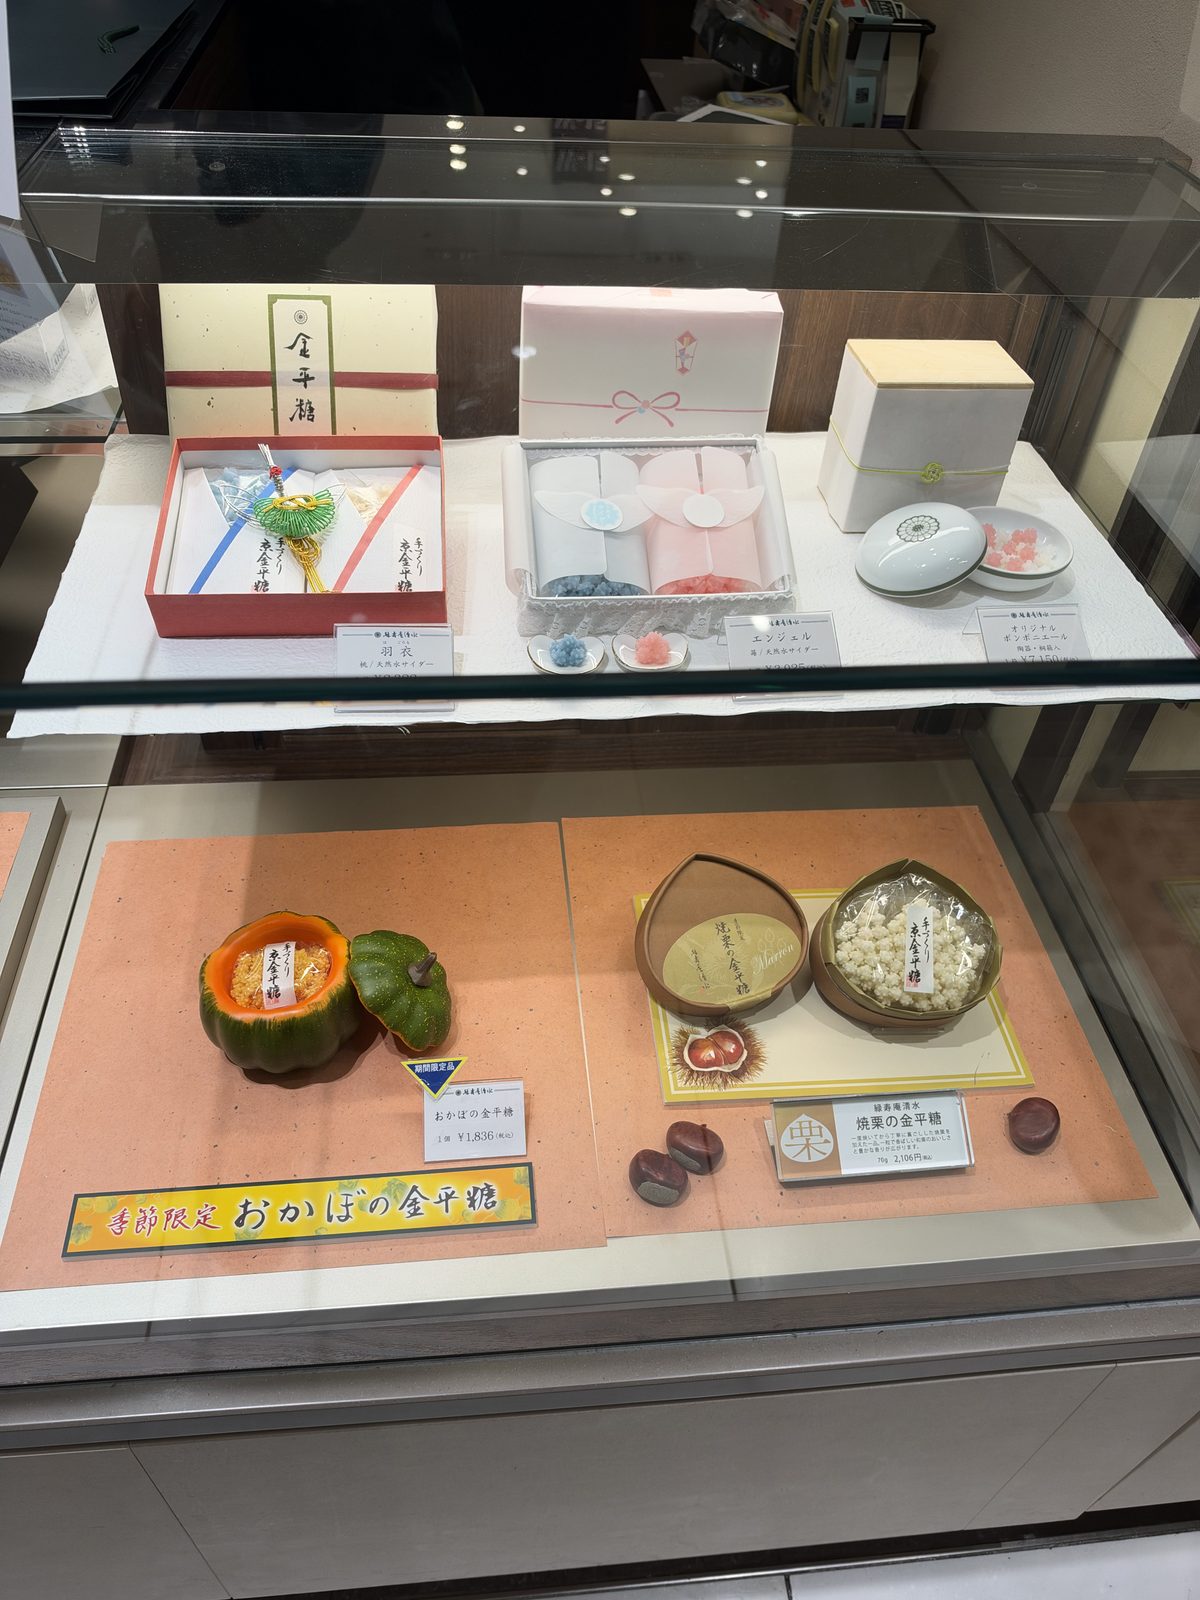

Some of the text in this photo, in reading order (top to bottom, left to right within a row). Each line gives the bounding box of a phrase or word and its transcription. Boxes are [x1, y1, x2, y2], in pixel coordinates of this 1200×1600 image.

[283, 332, 316, 422] 金平糖
[413, 537, 424, 577] 手づくり
[752, 631, 812, 642] エンジェル
[1012, 624, 1057, 632] オリジナル
[282, 942, 291, 977] 手づくり
[908, 922, 921, 984] 京金平糖
[921, 916, 930, 963] 手づくり
[266, 949, 282, 1000] 京金平糖
[414, 1061, 455, 1073] 期間限定品
[434, 1106, 514, 1122] おかぼの金平糖
[856, 1111, 942, 1131] 焼栗の金平糖
[784, 1120, 831, 1161] 栗
[107, 1182, 498, 1237] 季節限定 おかぼの金平糖
